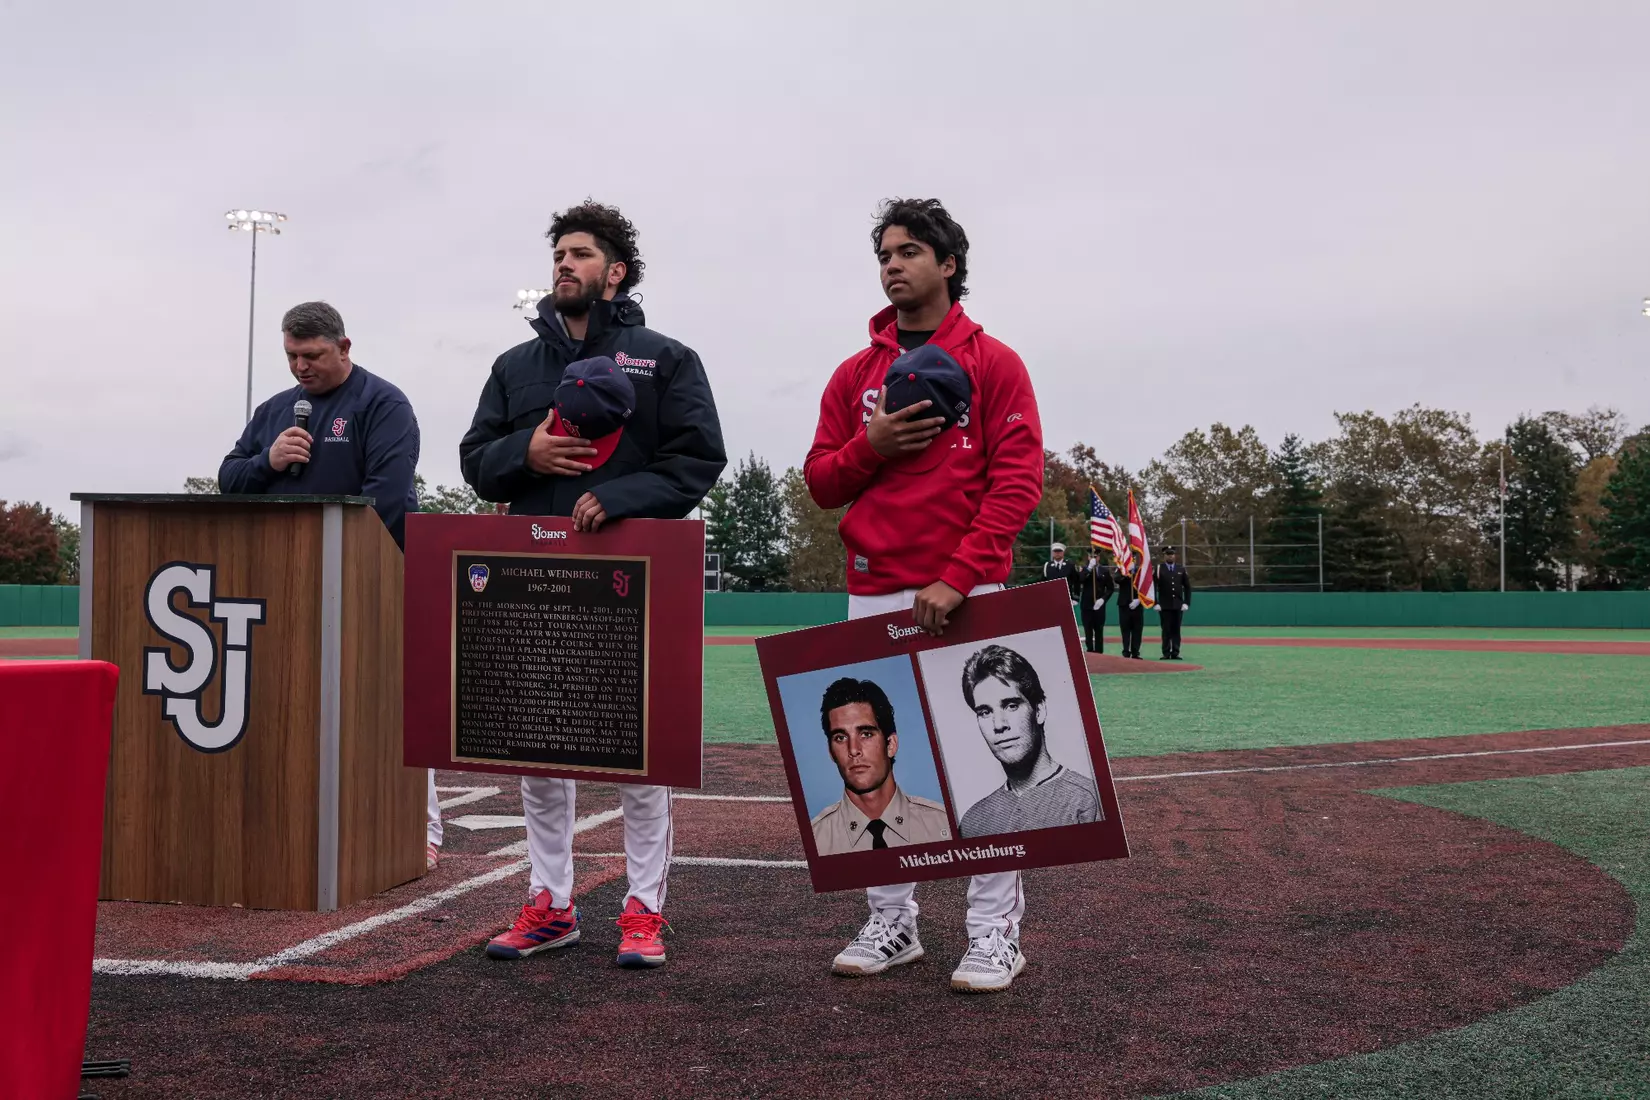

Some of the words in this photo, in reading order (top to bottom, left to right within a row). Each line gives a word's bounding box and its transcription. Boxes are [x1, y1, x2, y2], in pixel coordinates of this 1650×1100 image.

[501, 568, 545, 578] MICHAEL
[547, 569, 598, 579] WEINBERG
[528, 583, 571, 593] 1967-2001
[547, 621, 608, 630] TOURNAMENT
[461, 626, 514, 635] OUTSTANDING
[566, 648, 600, 656] CRASHED
[551, 656, 586, 664] WITHOUT
[522, 663, 561, 672] FIREHOUSE
[516, 672, 550, 680] LOOKING
[562, 683, 596, 691] PERISHED
[518, 689, 562, 698] ALONGSIDE
[527, 706, 560, 715] DECADES
[562, 708, 598, 717] REMOVED
[462, 720, 505, 728] MONUMENT
[572, 718, 613, 726] DEDICATE
[514, 731, 543, 739] SHARED
[544, 733, 596, 743] APPRECIATION
[461, 737, 501, 745] CONSTANT
[506, 740, 546, 748] REMINDER
[580, 744, 616, 753] BRAVERY
[899, 849, 954, 868] Michael
[954, 844, 1026, 861] Weinburg
